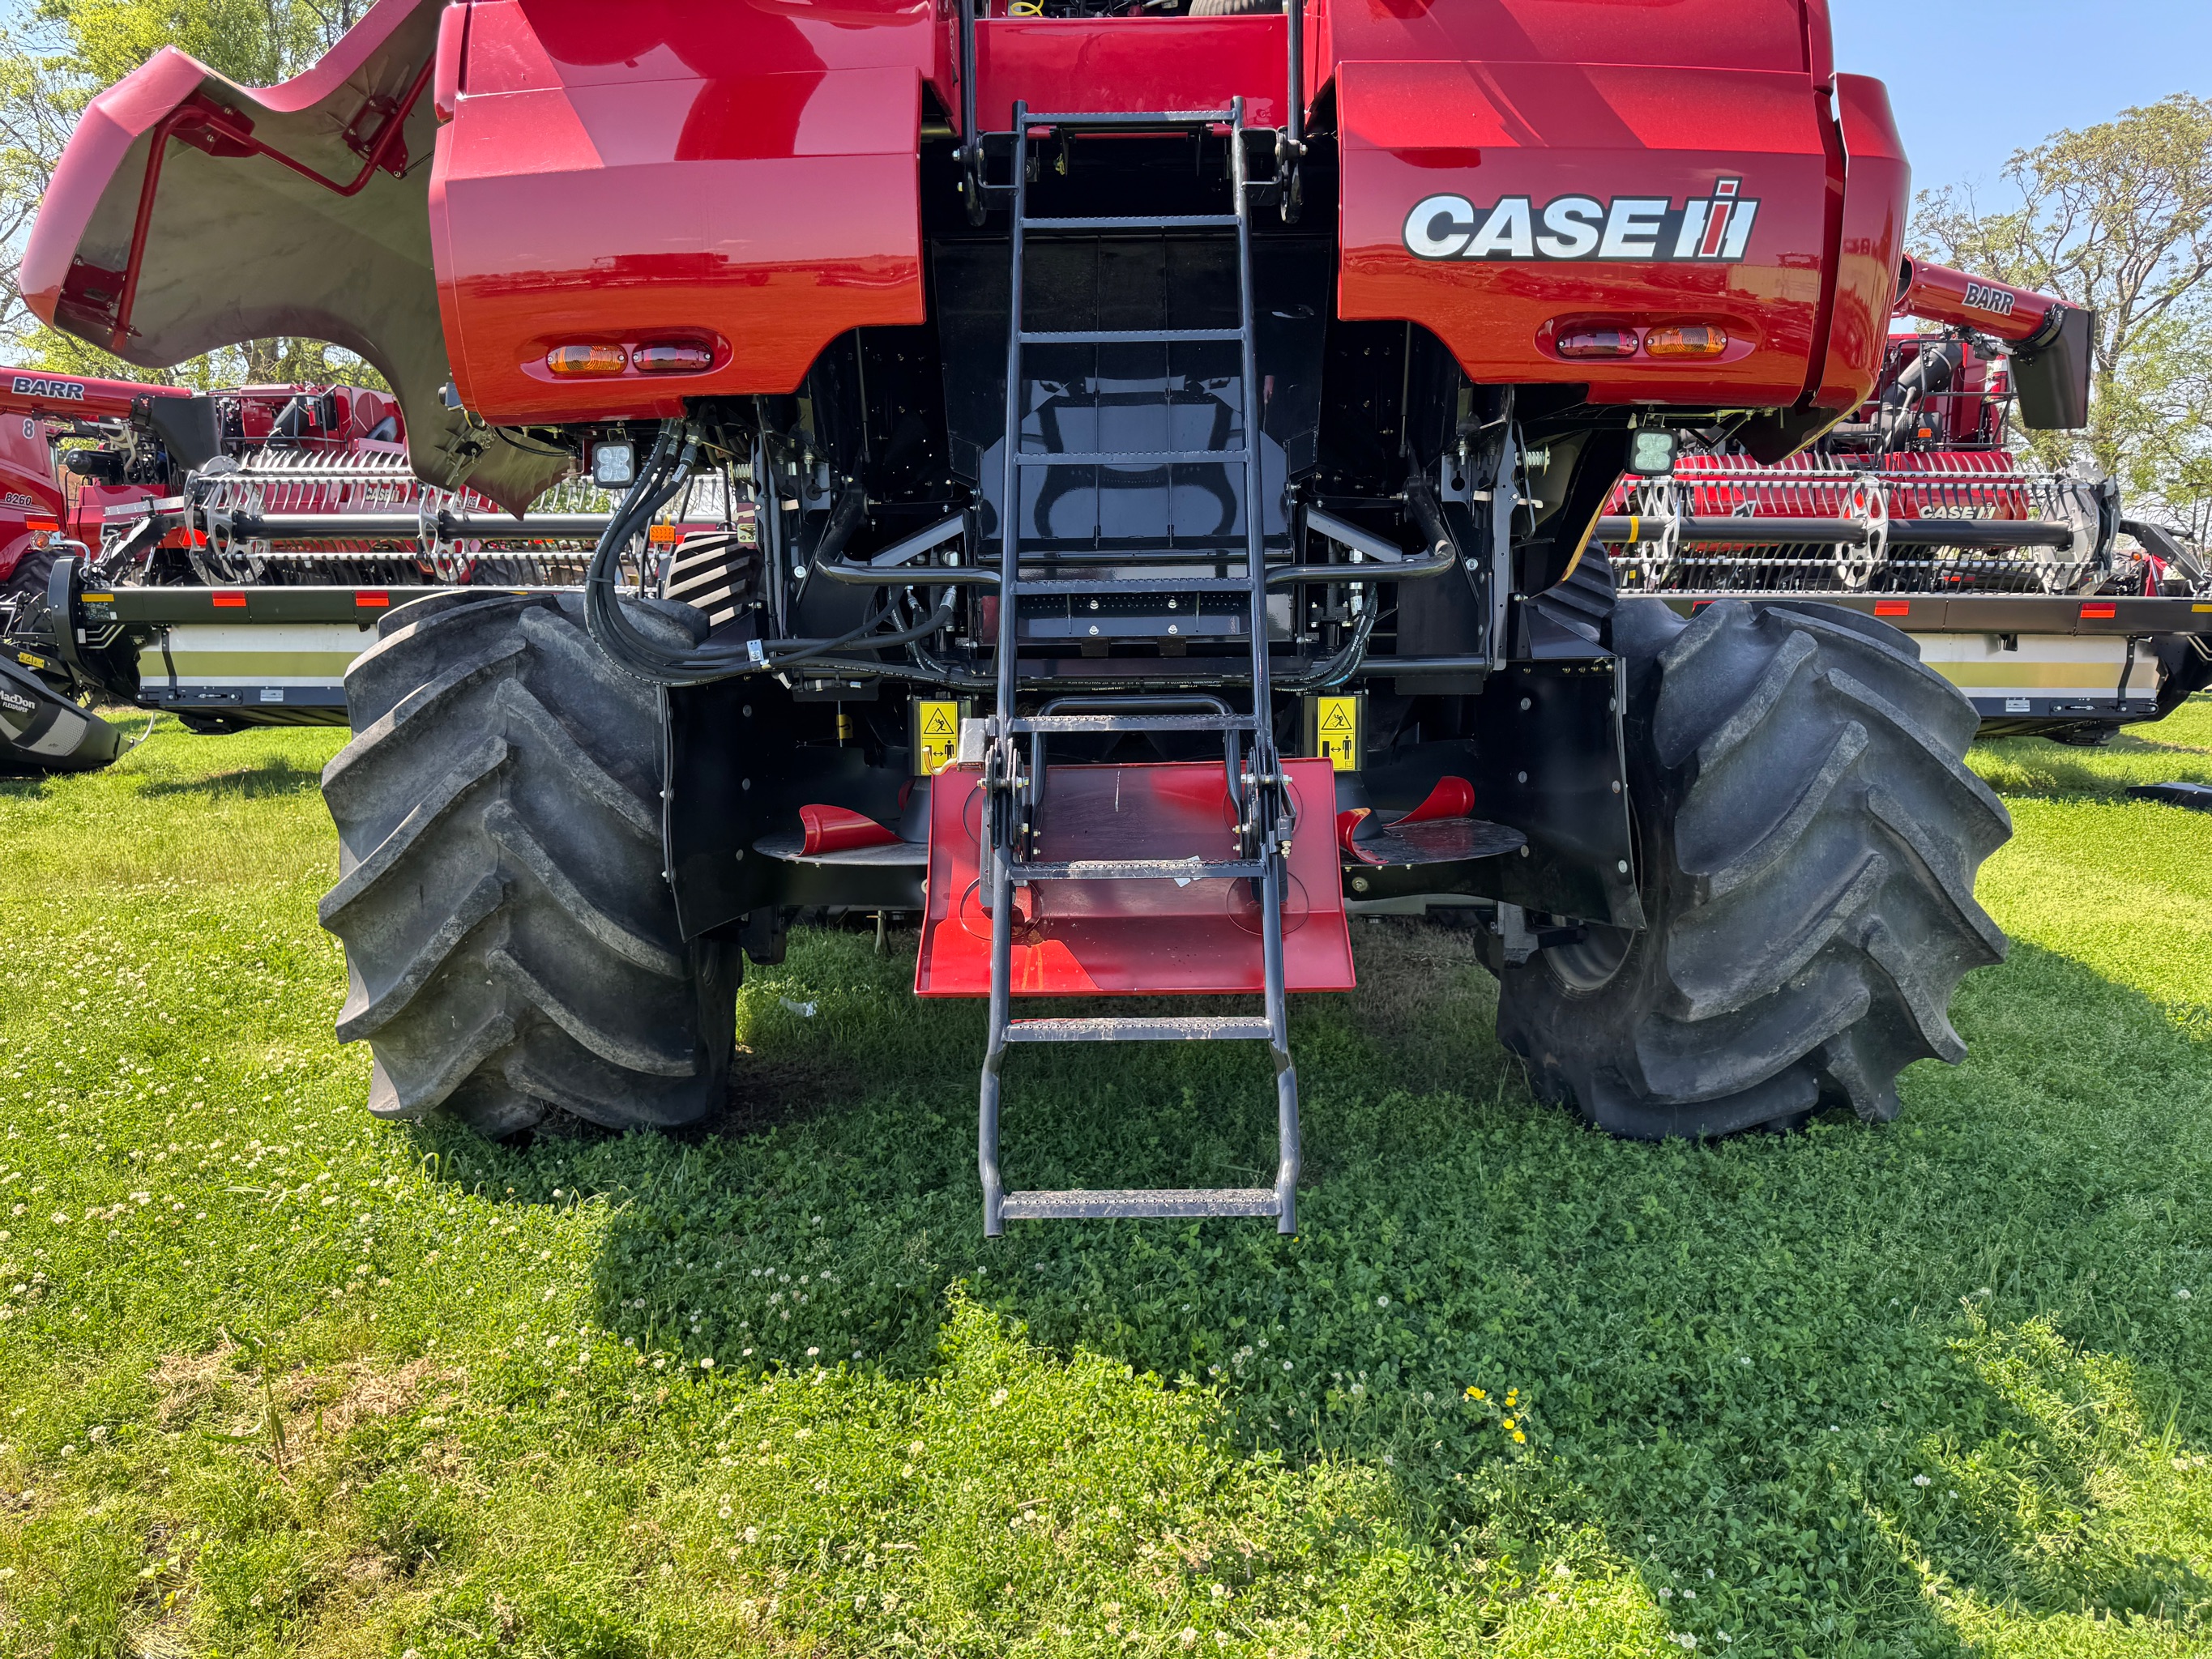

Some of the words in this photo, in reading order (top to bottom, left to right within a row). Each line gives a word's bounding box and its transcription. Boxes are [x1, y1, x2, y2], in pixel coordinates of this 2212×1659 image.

[1404, 195, 1669, 258] CASE
[1962, 283, 2015, 317] BARR
[11, 377, 84, 401] BARR
[23, 418, 35, 439] 8
[5, 492, 32, 507] 8260
[1920, 505, 1976, 519] CASE
